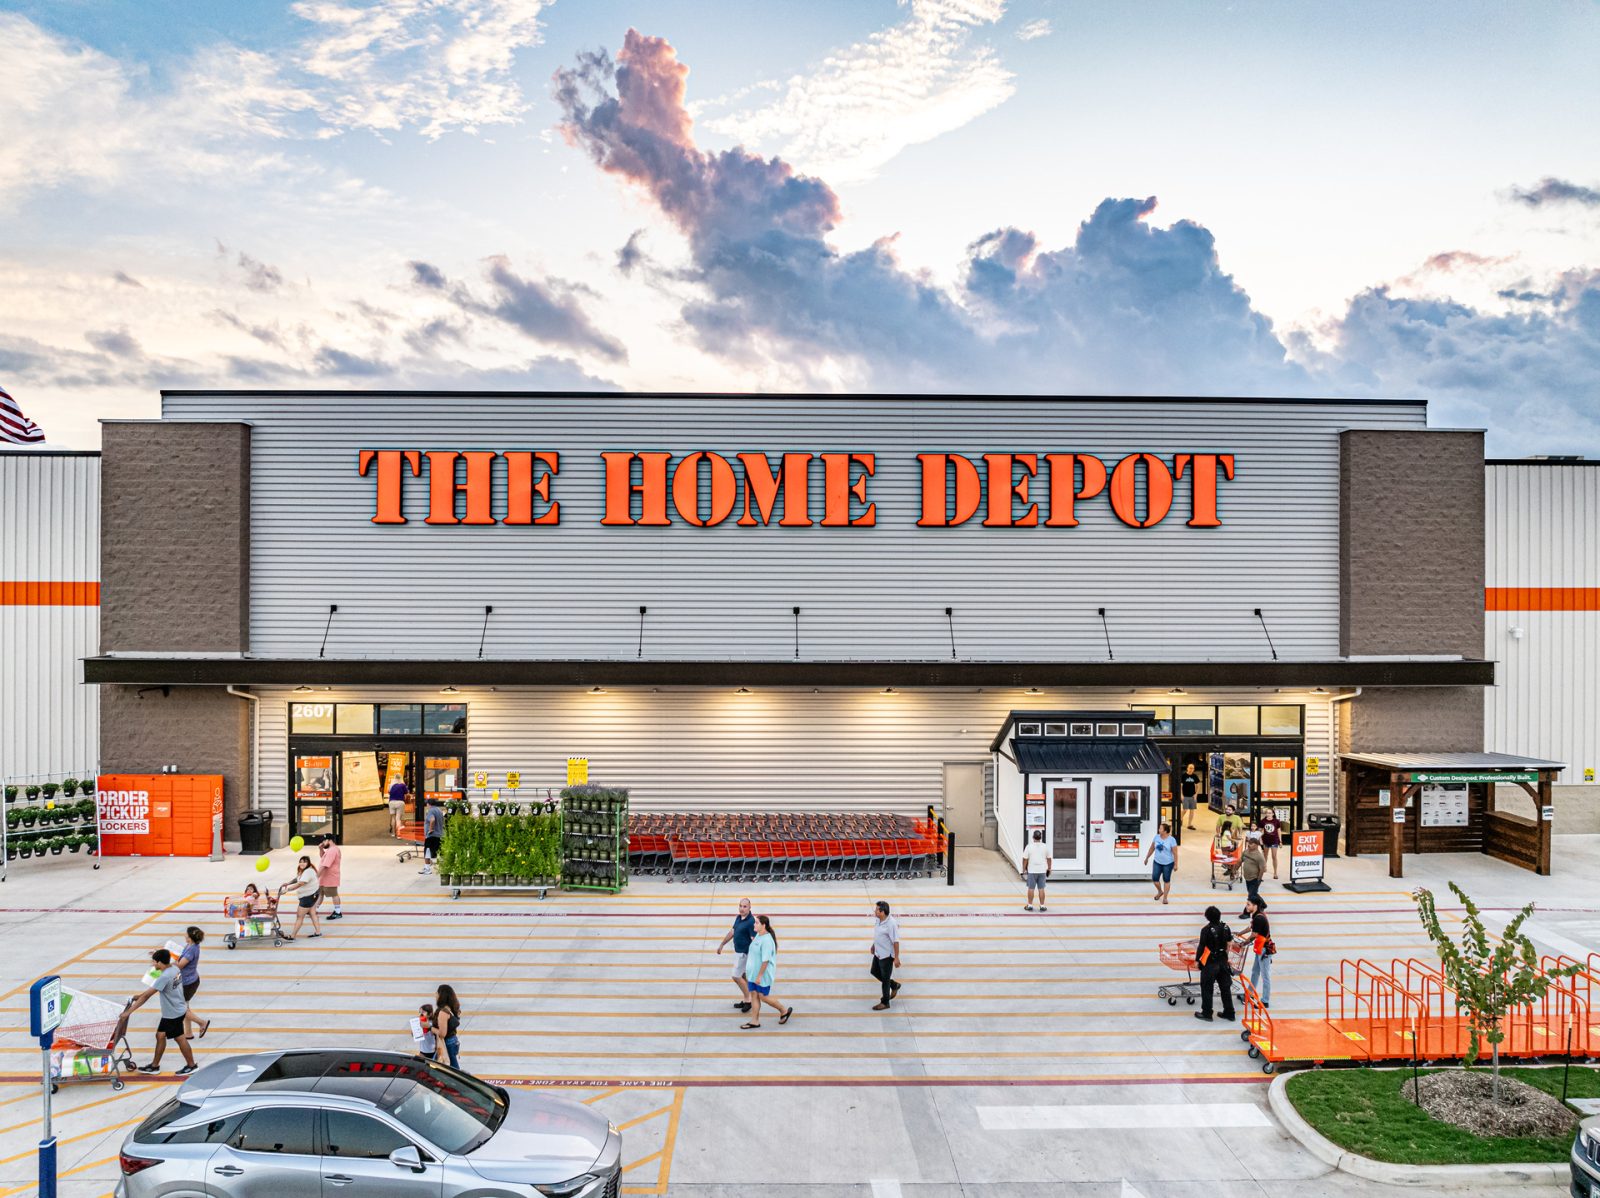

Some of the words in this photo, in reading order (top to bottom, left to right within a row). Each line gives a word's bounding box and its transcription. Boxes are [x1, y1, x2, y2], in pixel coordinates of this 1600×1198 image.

[358, 449, 561, 526] THE
[600, 451, 877, 528] HOME
[916, 452, 1235, 529] DEPOT
[292, 704, 333, 718] 2607
[98, 790, 149, 806] ORDER
[98, 806, 149, 820] PICKUP
[100, 822, 147, 831] LOCKERS
[1298, 835, 1317, 844] EXIT
[1296, 844, 1319, 852] ONLY
